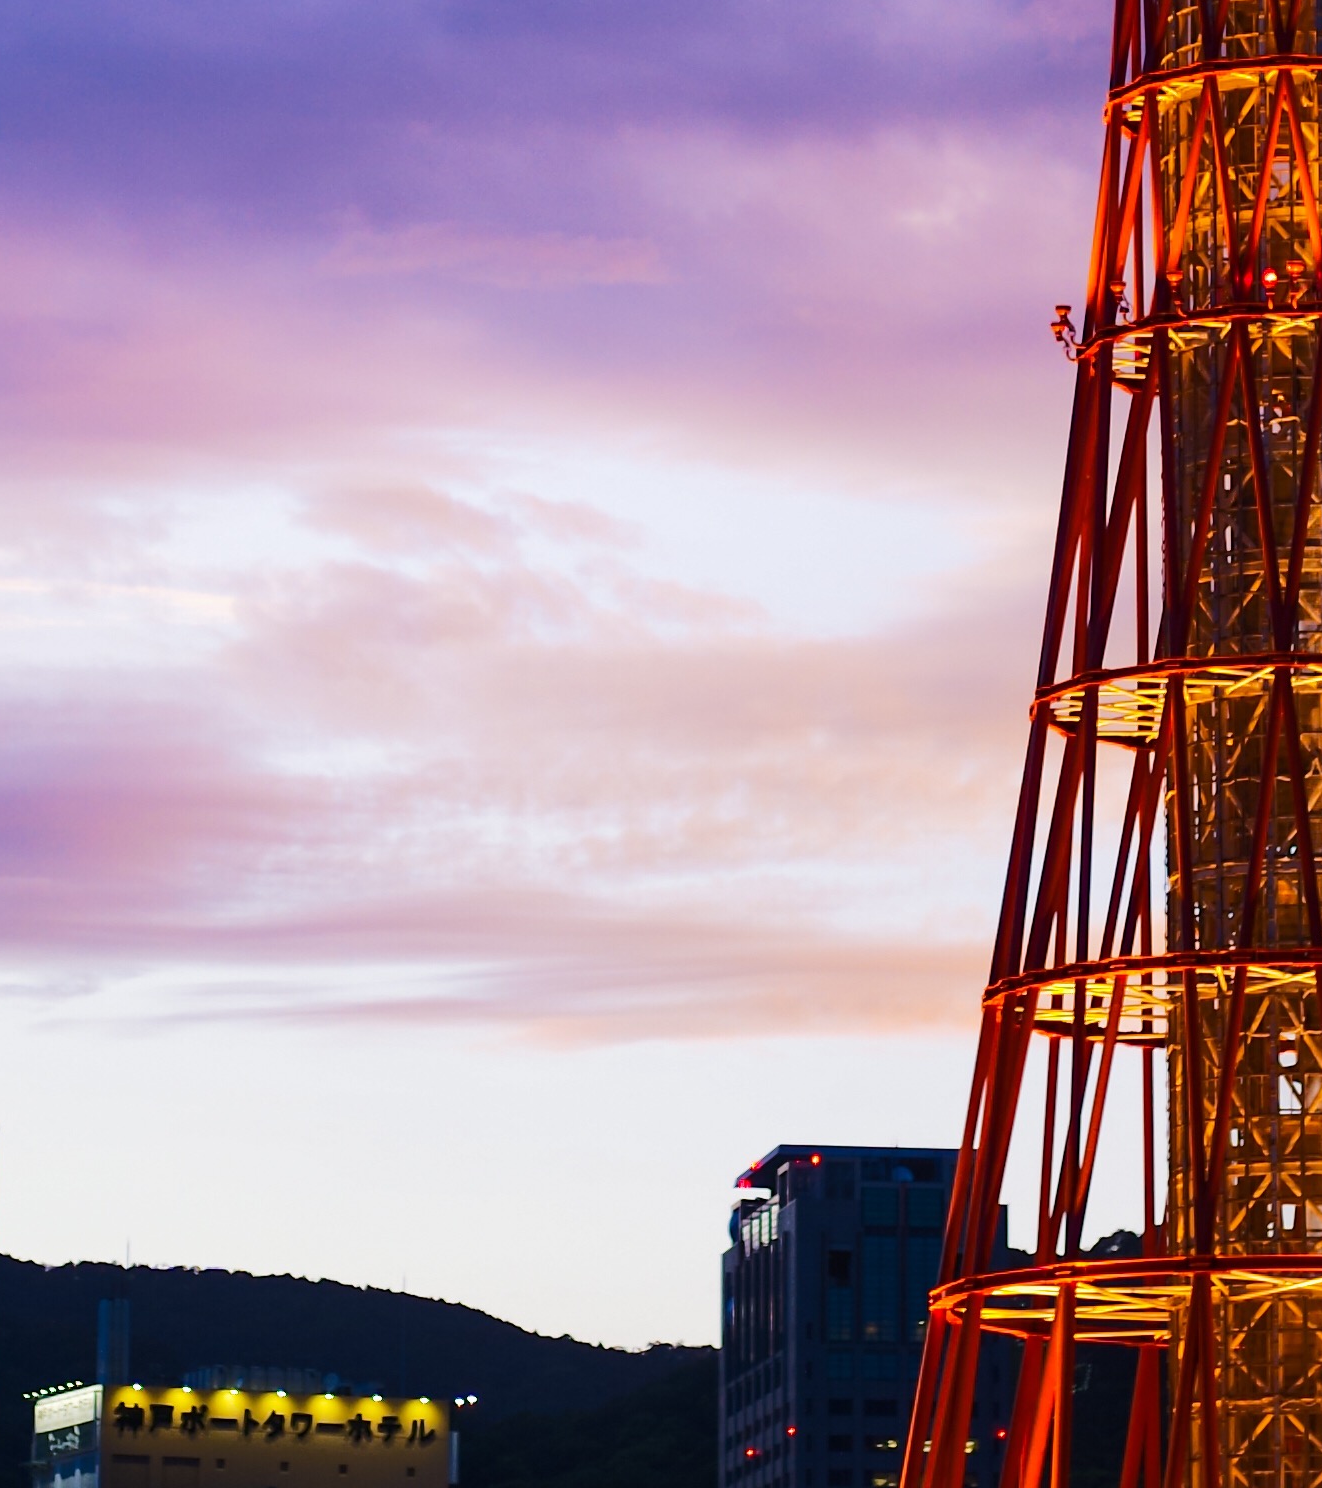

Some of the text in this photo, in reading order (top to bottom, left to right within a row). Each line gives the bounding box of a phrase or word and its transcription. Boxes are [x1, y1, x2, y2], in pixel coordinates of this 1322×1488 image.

[113, 1401, 435, 1442] 神戸ポートタワーホテル
